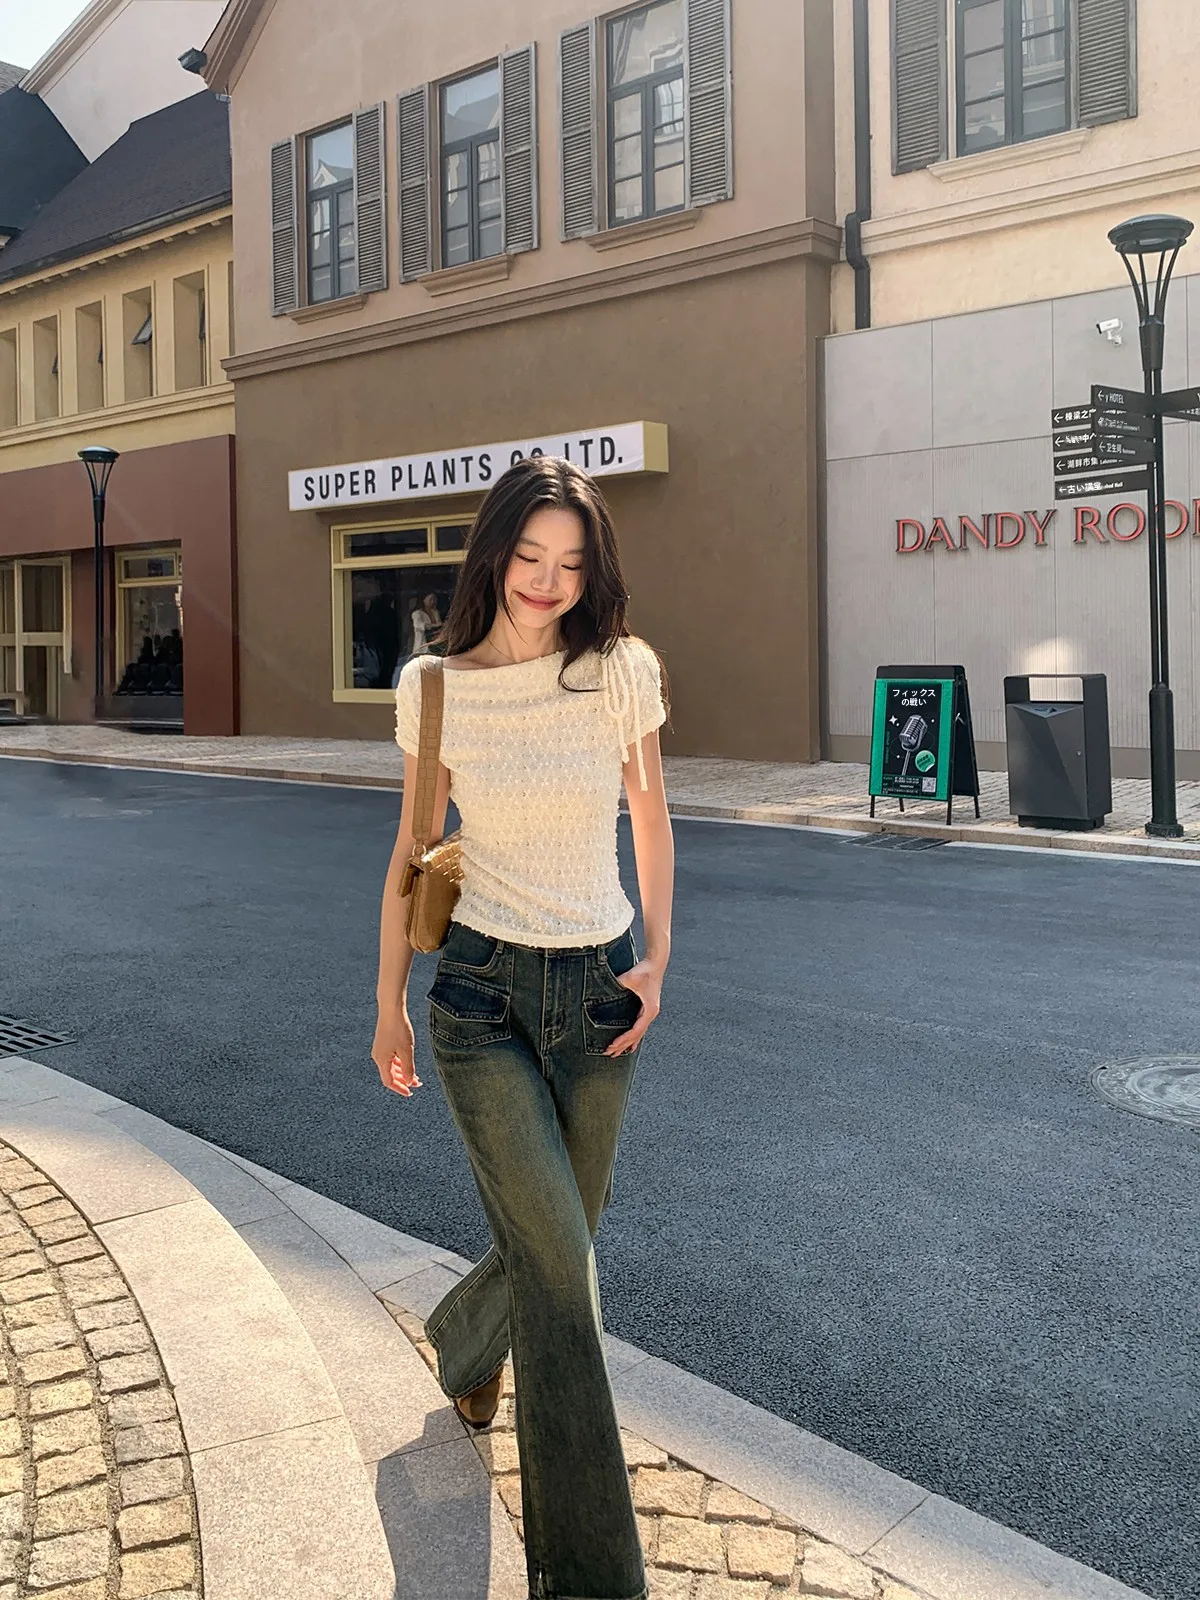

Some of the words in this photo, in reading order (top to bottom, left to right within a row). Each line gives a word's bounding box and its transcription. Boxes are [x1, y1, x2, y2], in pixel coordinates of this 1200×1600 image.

[1109, 392, 1125, 405] HOTEL
[304, 469, 376, 501] SUPER
[392, 453, 492, 491] PLANTS
[896, 508, 1058, 552] DANDY
[1073, 498, 1200, 545] ROO
[892, 688, 936, 698] フィックス
[901, 697, 927, 707] の戦い
